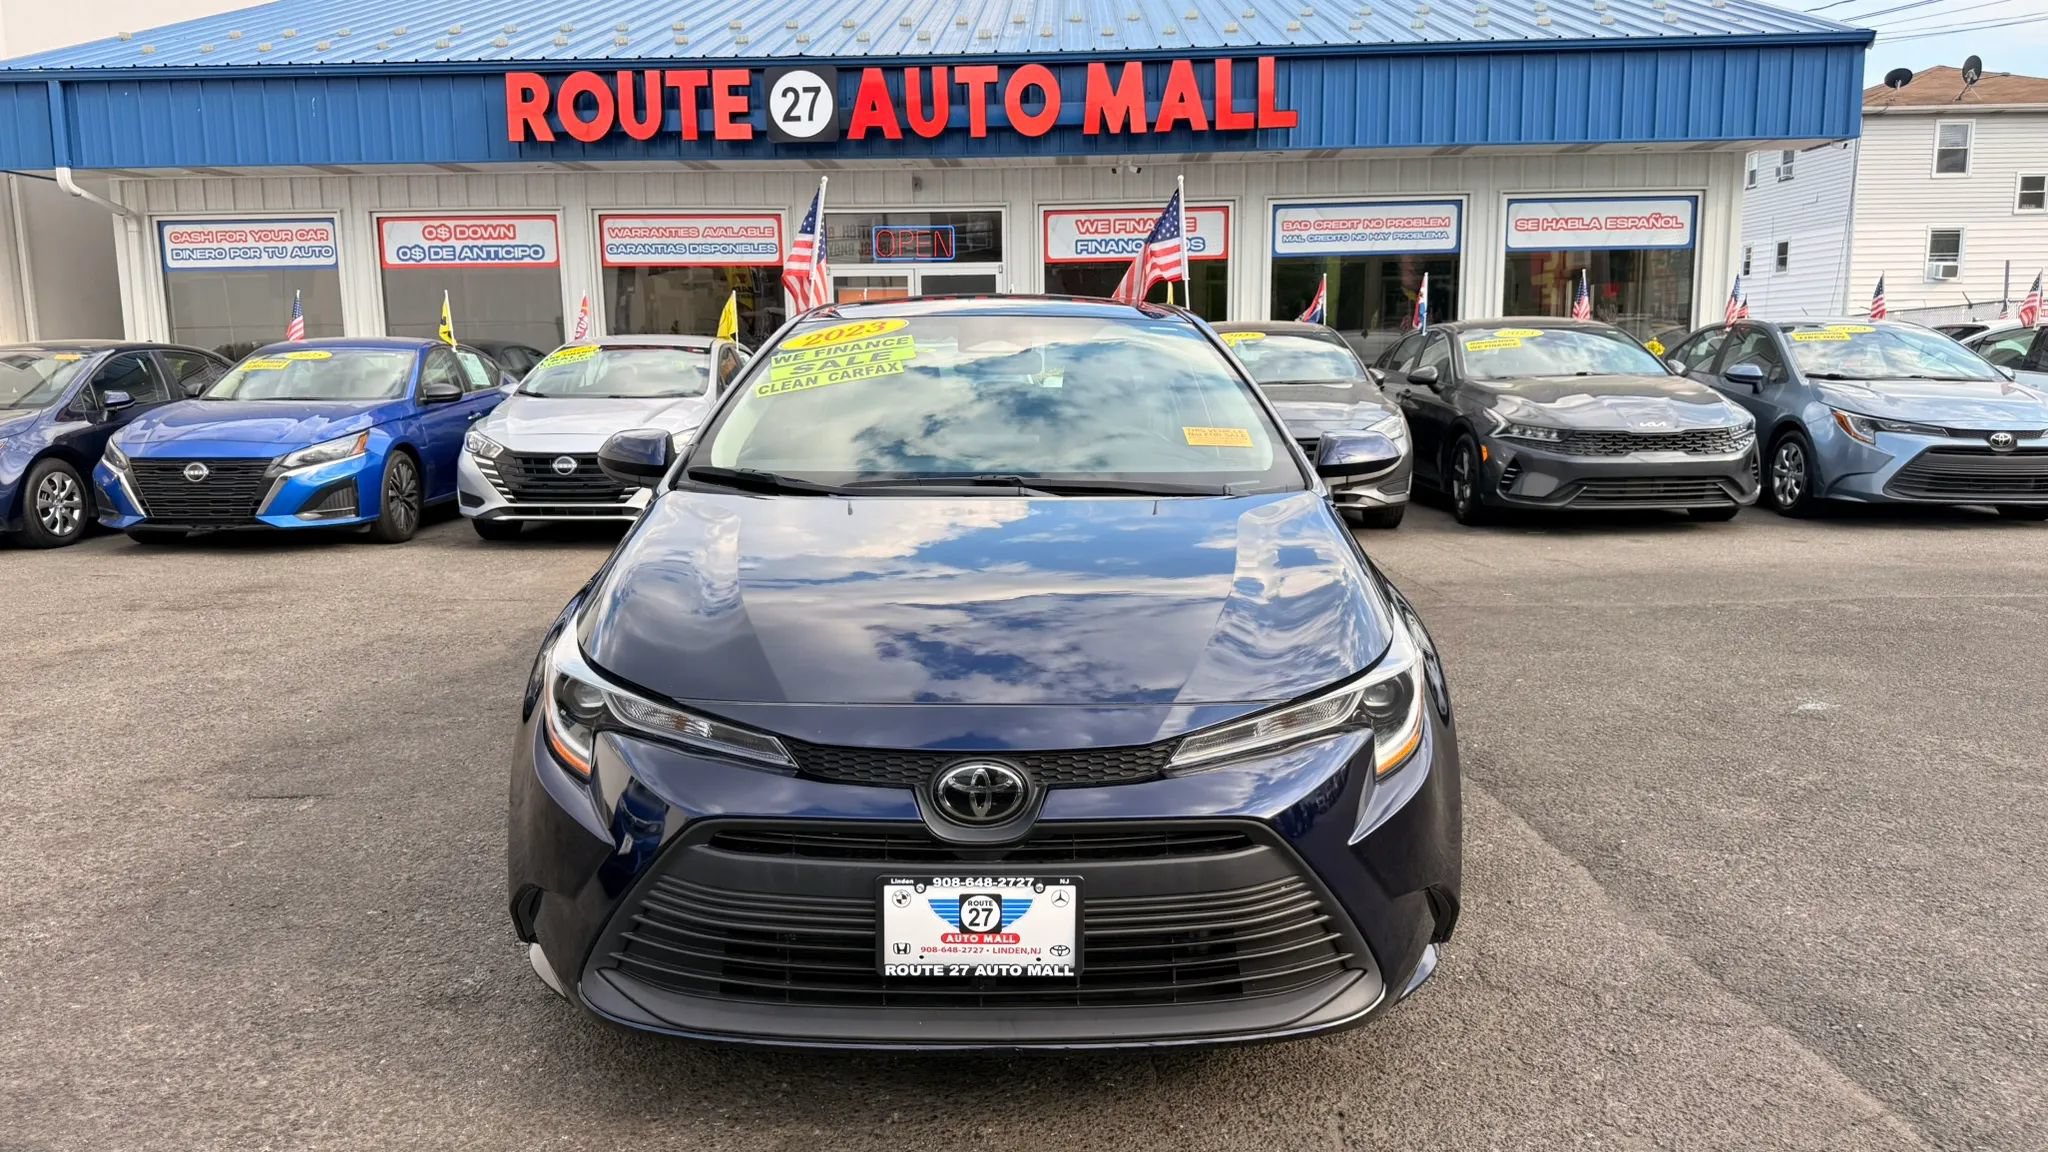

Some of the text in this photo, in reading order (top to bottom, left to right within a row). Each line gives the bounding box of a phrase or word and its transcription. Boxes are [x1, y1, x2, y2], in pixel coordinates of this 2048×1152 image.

[505, 56, 1299, 144] ROUTE 27 AUTO MALL
[1076, 217, 1197, 234] WE FINAE
[1282, 217, 1450, 231] BAD CREDIT NO PROBLEM
[1515, 213, 1683, 231] SE HABLA ESPAÑOL
[170, 228, 329, 244] CASH FOR YOUR CAR
[454, 224, 516, 240] DOWN
[608, 227, 775, 238] WARRANTIES AVAILABLE
[1282, 231, 1449, 243] MAL CREDITO NO HAY PROBLEMA
[607, 243, 778, 255] GARANTIAS DISPONIBLES
[876, 229, 953, 258] OPEN
[171, 246, 334, 261] DINERO POR TU AUTO
[428, 246, 456, 260] DE
[458, 244, 545, 261] ANTICIPO
[802, 320, 887, 347] 2023
[773, 336, 909, 365] WE FINANCE
[790, 351, 893, 375] SALE
[757, 362, 899, 395] CLEAN CARFAX
[933, 877, 1034, 888] 908-648-2727
[968, 908, 993, 927] 27
[946, 933, 1015, 944] AUTO MALL
[920, 946, 1042, 955] 908-648-2727 LINDEN,NJ
[885, 964, 1074, 976] ROUTE 27 AUTO MALL
